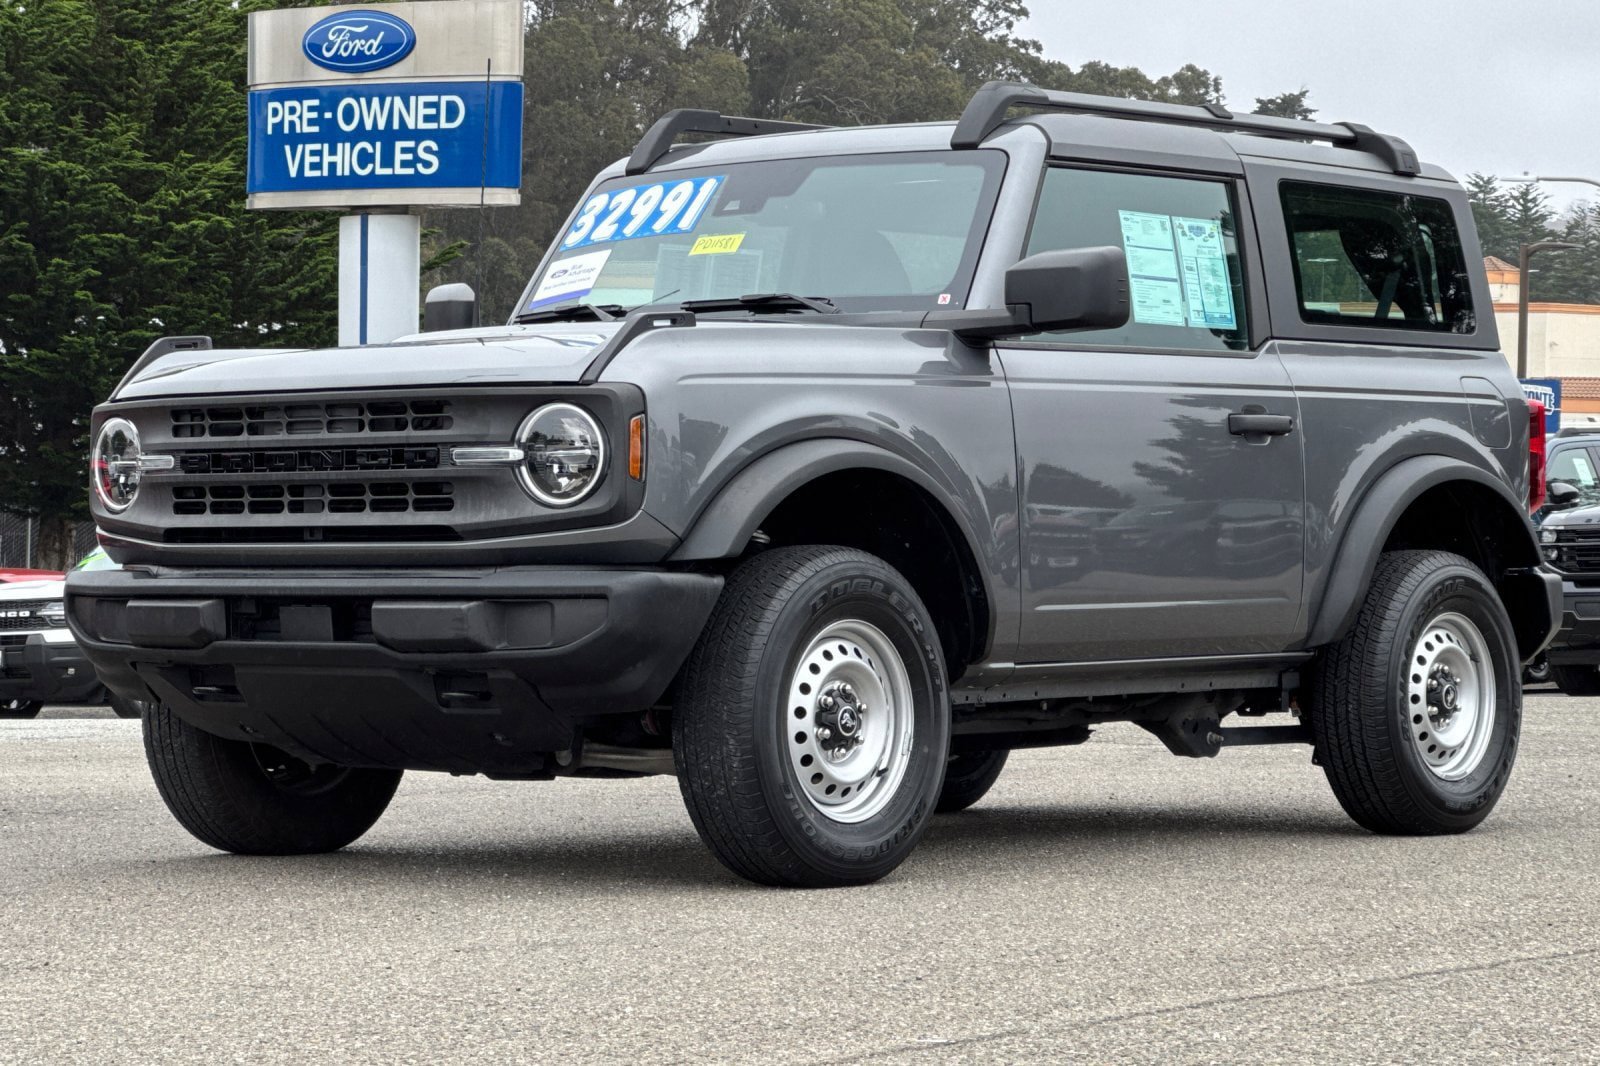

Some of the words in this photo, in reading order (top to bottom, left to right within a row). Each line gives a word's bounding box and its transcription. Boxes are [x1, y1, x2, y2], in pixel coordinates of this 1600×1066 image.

[322, 25, 385, 58] Ford
[267, 95, 466, 135] PRE-OWNED
[284, 140, 439, 178] VEHICLES
[565, 178, 718, 247] 32991
[180, 447, 440, 474] BRONCO
